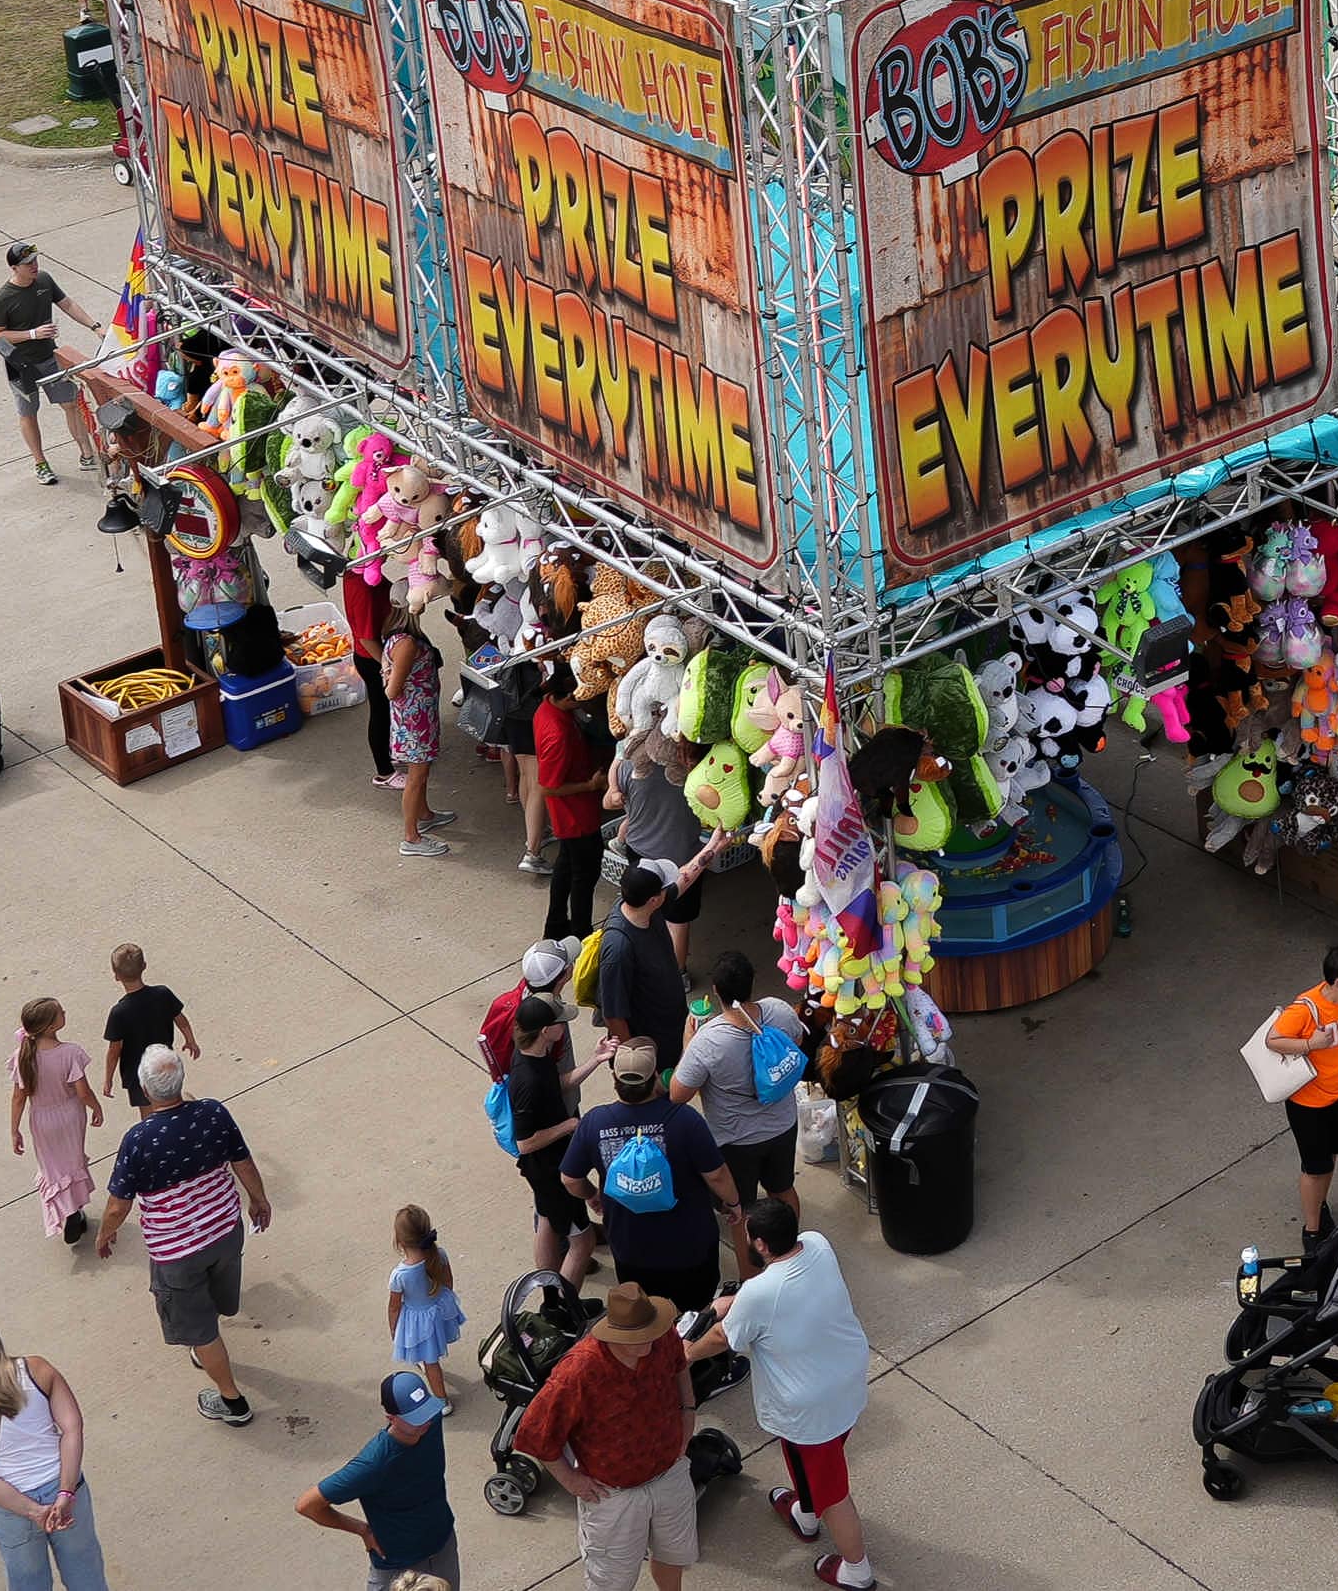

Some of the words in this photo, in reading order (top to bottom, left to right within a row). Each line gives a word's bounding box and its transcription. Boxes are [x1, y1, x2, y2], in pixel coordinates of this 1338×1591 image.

[534, 6, 629, 111] FISHIN'
[632, 47, 721, 147] HOLE
[870, 3, 1032, 168] BOB'S
[158, 93, 400, 338] EVERYTIME
[508, 107, 678, 328] PRIZE
[977, 94, 1209, 322] PRIZE
[463, 246, 764, 537] EVERYTIME
[892, 228, 1315, 537] EVERYTIME
[316, 697, 340, 711] SMALL
[599, 1127, 619, 1139] BASS
